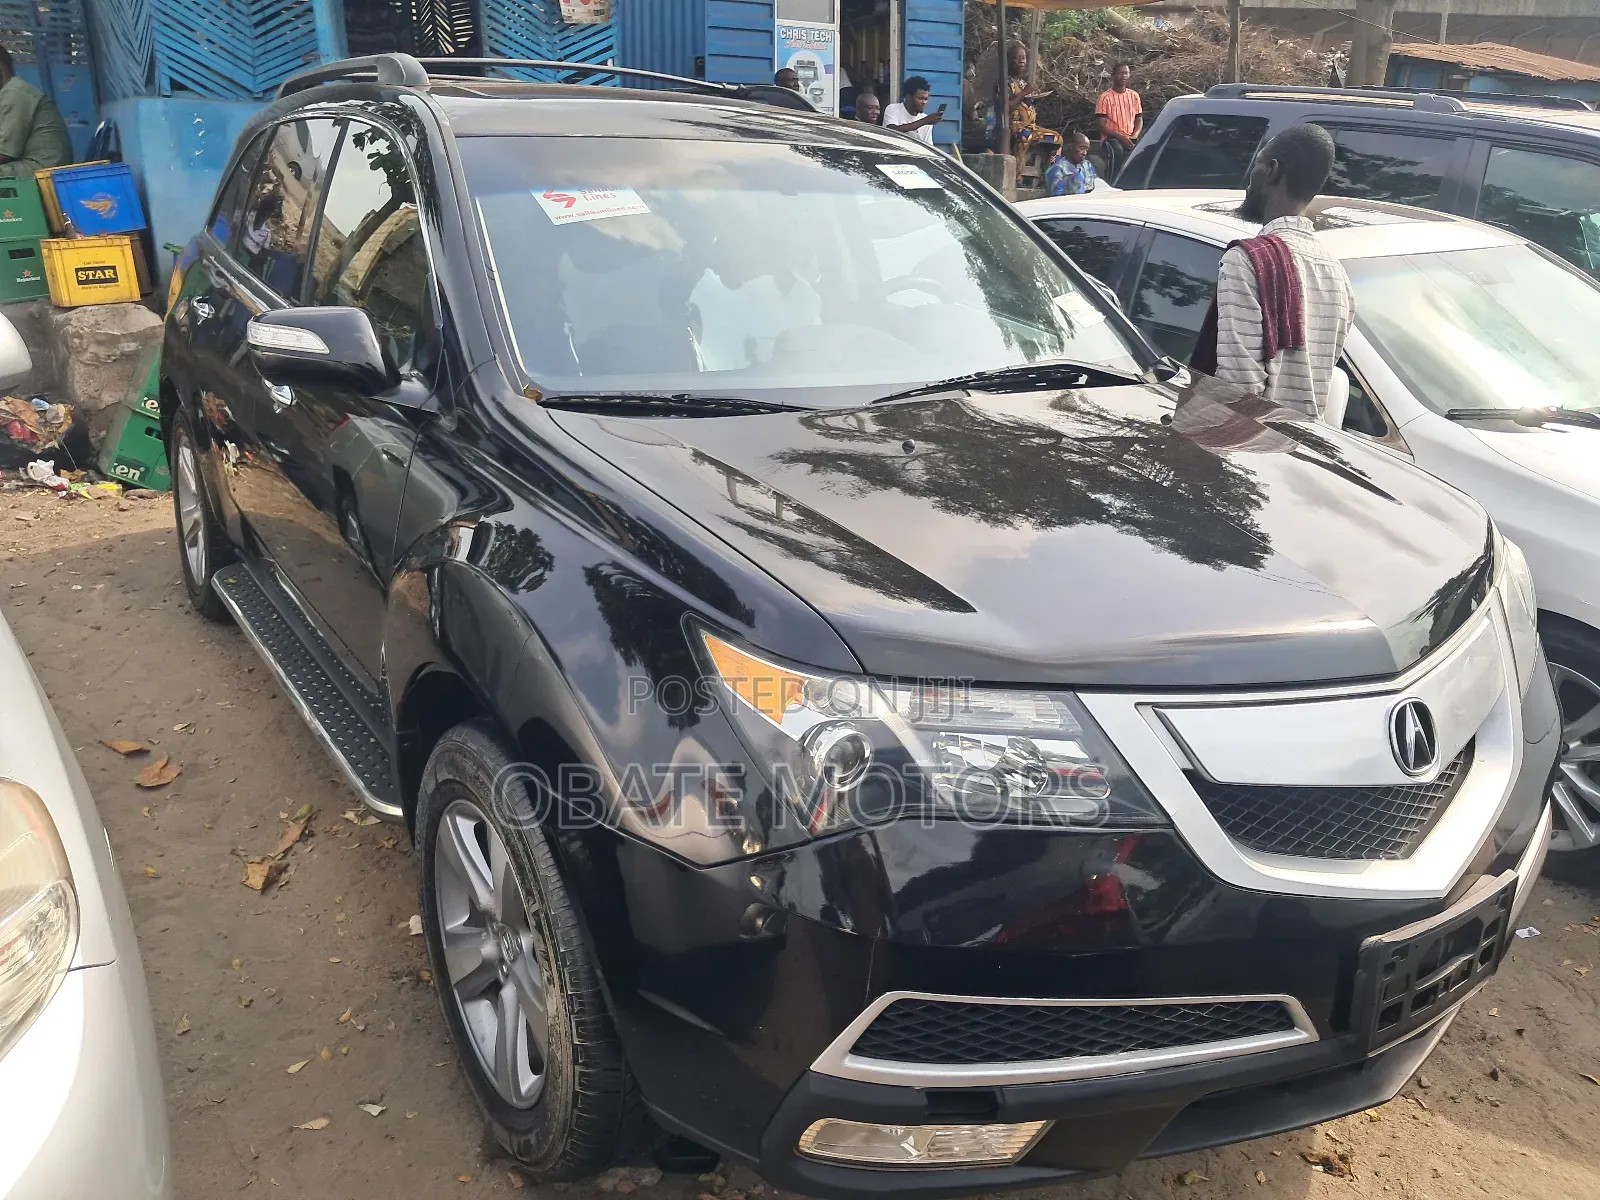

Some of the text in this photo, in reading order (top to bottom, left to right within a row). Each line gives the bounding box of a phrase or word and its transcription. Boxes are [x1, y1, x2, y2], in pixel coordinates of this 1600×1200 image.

[780, 28, 833, 43] CHRIS TECH
[583, 192, 617, 202] Lines
[77, 269, 117, 281] STAR
